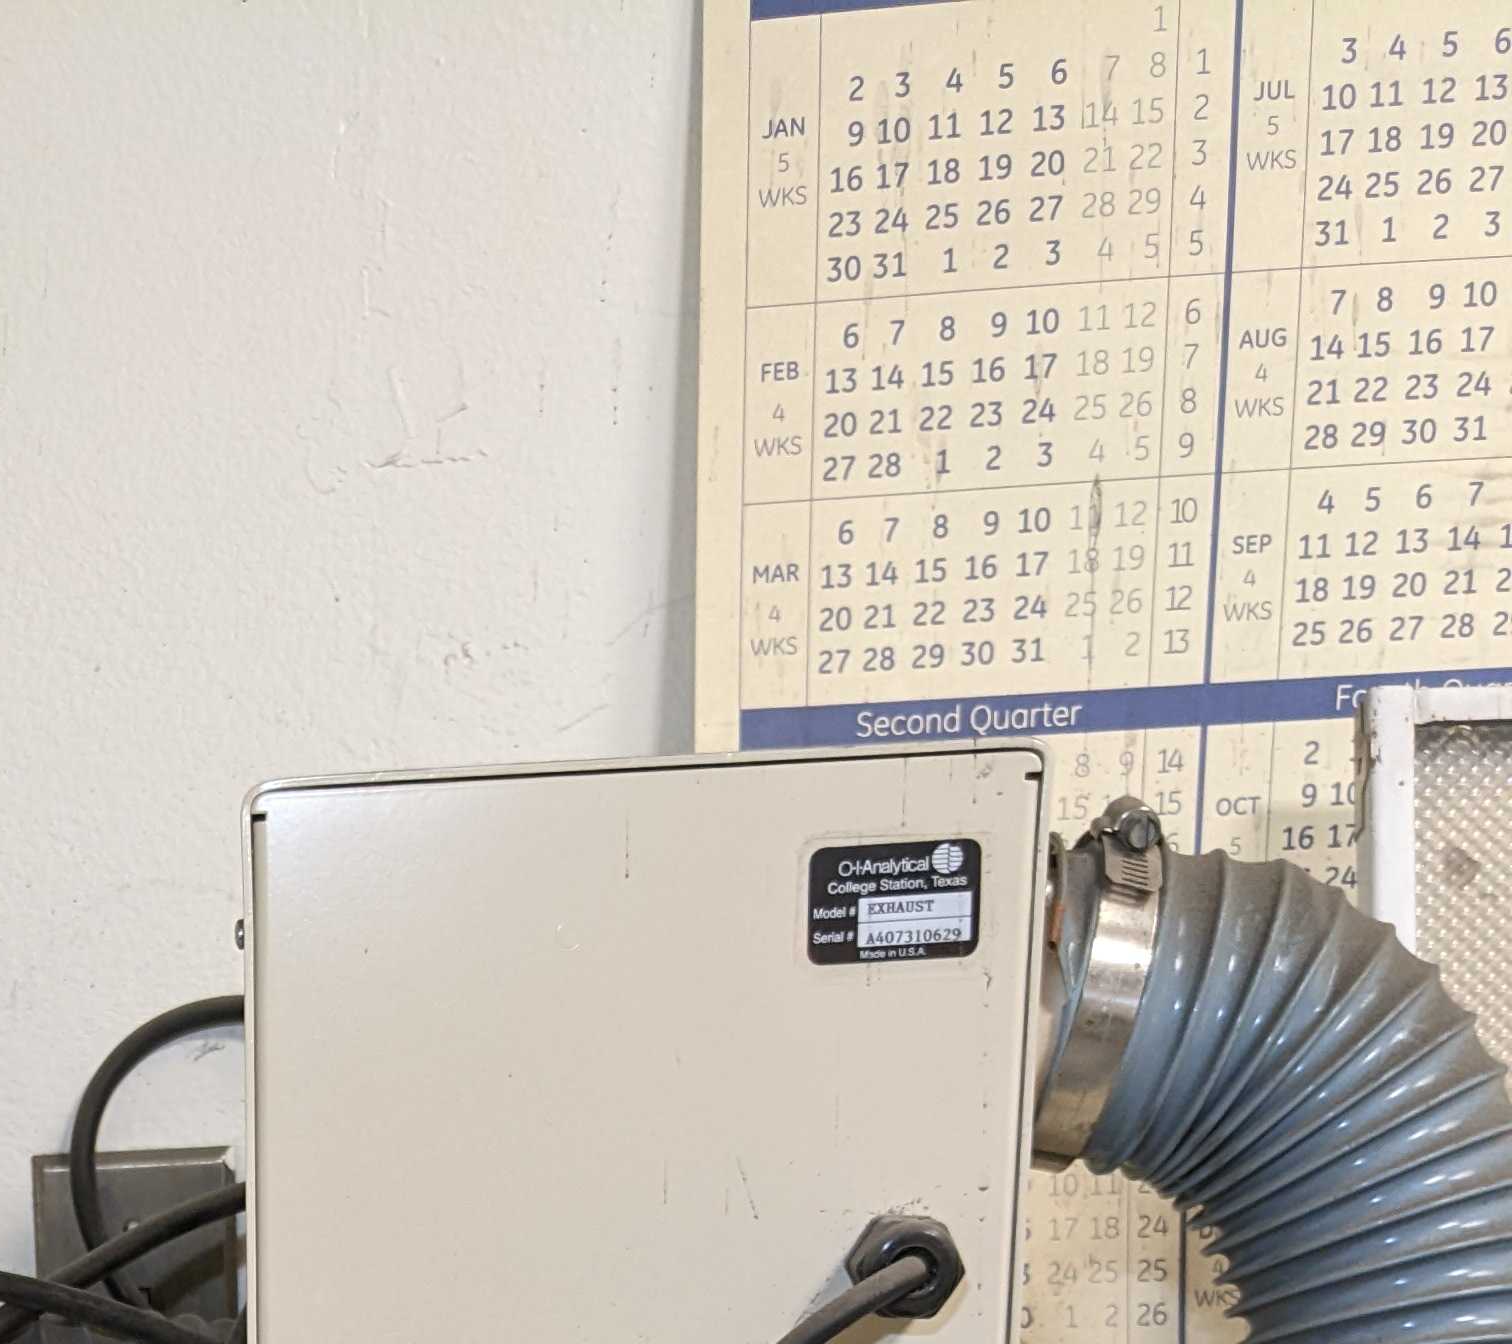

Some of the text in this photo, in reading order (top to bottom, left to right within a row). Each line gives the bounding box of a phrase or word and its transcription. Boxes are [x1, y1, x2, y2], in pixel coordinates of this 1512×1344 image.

[1341, 27, 1512, 64] 3 4 5 6
[849, 58, 1067, 102] 2 3 4 5 6
[1253, 80, 1295, 101] JUL
[1322, 74, 1508, 111] 10 11 12 13
[762, 116, 805, 139] JAN
[848, 104, 1065, 147] 9 10 11 12 13
[1267, 115, 1279, 135] 5
[1321, 119, 1507, 156] 17 18 19 20
[779, 152, 789, 172] 5
[831, 149, 1065, 193] 16 17 18 19 20
[1246, 149, 1296, 170] WKS
[1317, 165, 1504, 201] 24 25 26 27
[759, 185, 807, 208] WKS
[828, 194, 1063, 238] 23 24 25 26 27
[1315, 211, 1500, 247] 31 1 2 3
[827, 239, 1060, 282] 30 31 1 2 3
[843, 308, 1059, 349] 6 7 8 9 10
[1239, 327, 1287, 349] AUG
[761, 361, 799, 382] FEB
[826, 353, 1058, 394] 13 14 15 16 17
[824, 397, 1056, 438] 20 21 22 23 24
[1235, 396, 1284, 418] WKS
[754, 435, 802, 457] WKS
[823, 442, 1053, 482] 27 28 1 2 3
[1232, 534, 1272, 555] SEP
[753, 563, 799, 584] MAR
[1223, 601, 1272, 621] WKS
[751, 636, 797, 656] WKS
[857, 703, 1082, 738] Second Quarter
[1075, 748, 1184, 777] 8 9 14
[1304, 740, 1320, 765] 2
[1057, 790, 1182, 820] 15 15
[1216, 796, 1261, 816] OCT
[1302, 783, 1317, 808] 9
[1282, 825, 1315, 851] 16
[827, 875, 968, 896] College Station, Texas
[813, 906, 847, 920] Model
[867, 899, 935, 915] EXHAUST
[812, 931, 845, 945] Serial
[866, 928, 963, 946] A407310629
[860, 949, 886, 960] Made
[888, 948, 897, 958] in
[1049, 1217, 1079, 1241] 17
[1090, 1216, 1120, 1240] 18
[1137, 1214, 1169, 1239] 24
[1047, 1260, 1078, 1285] 24
[1088, 1258, 1119, 1284] 25
[1137, 1259, 1168, 1283] 25
[1105, 1304, 1119, 1327] 2
[1136, 1303, 1168, 1327] 26
